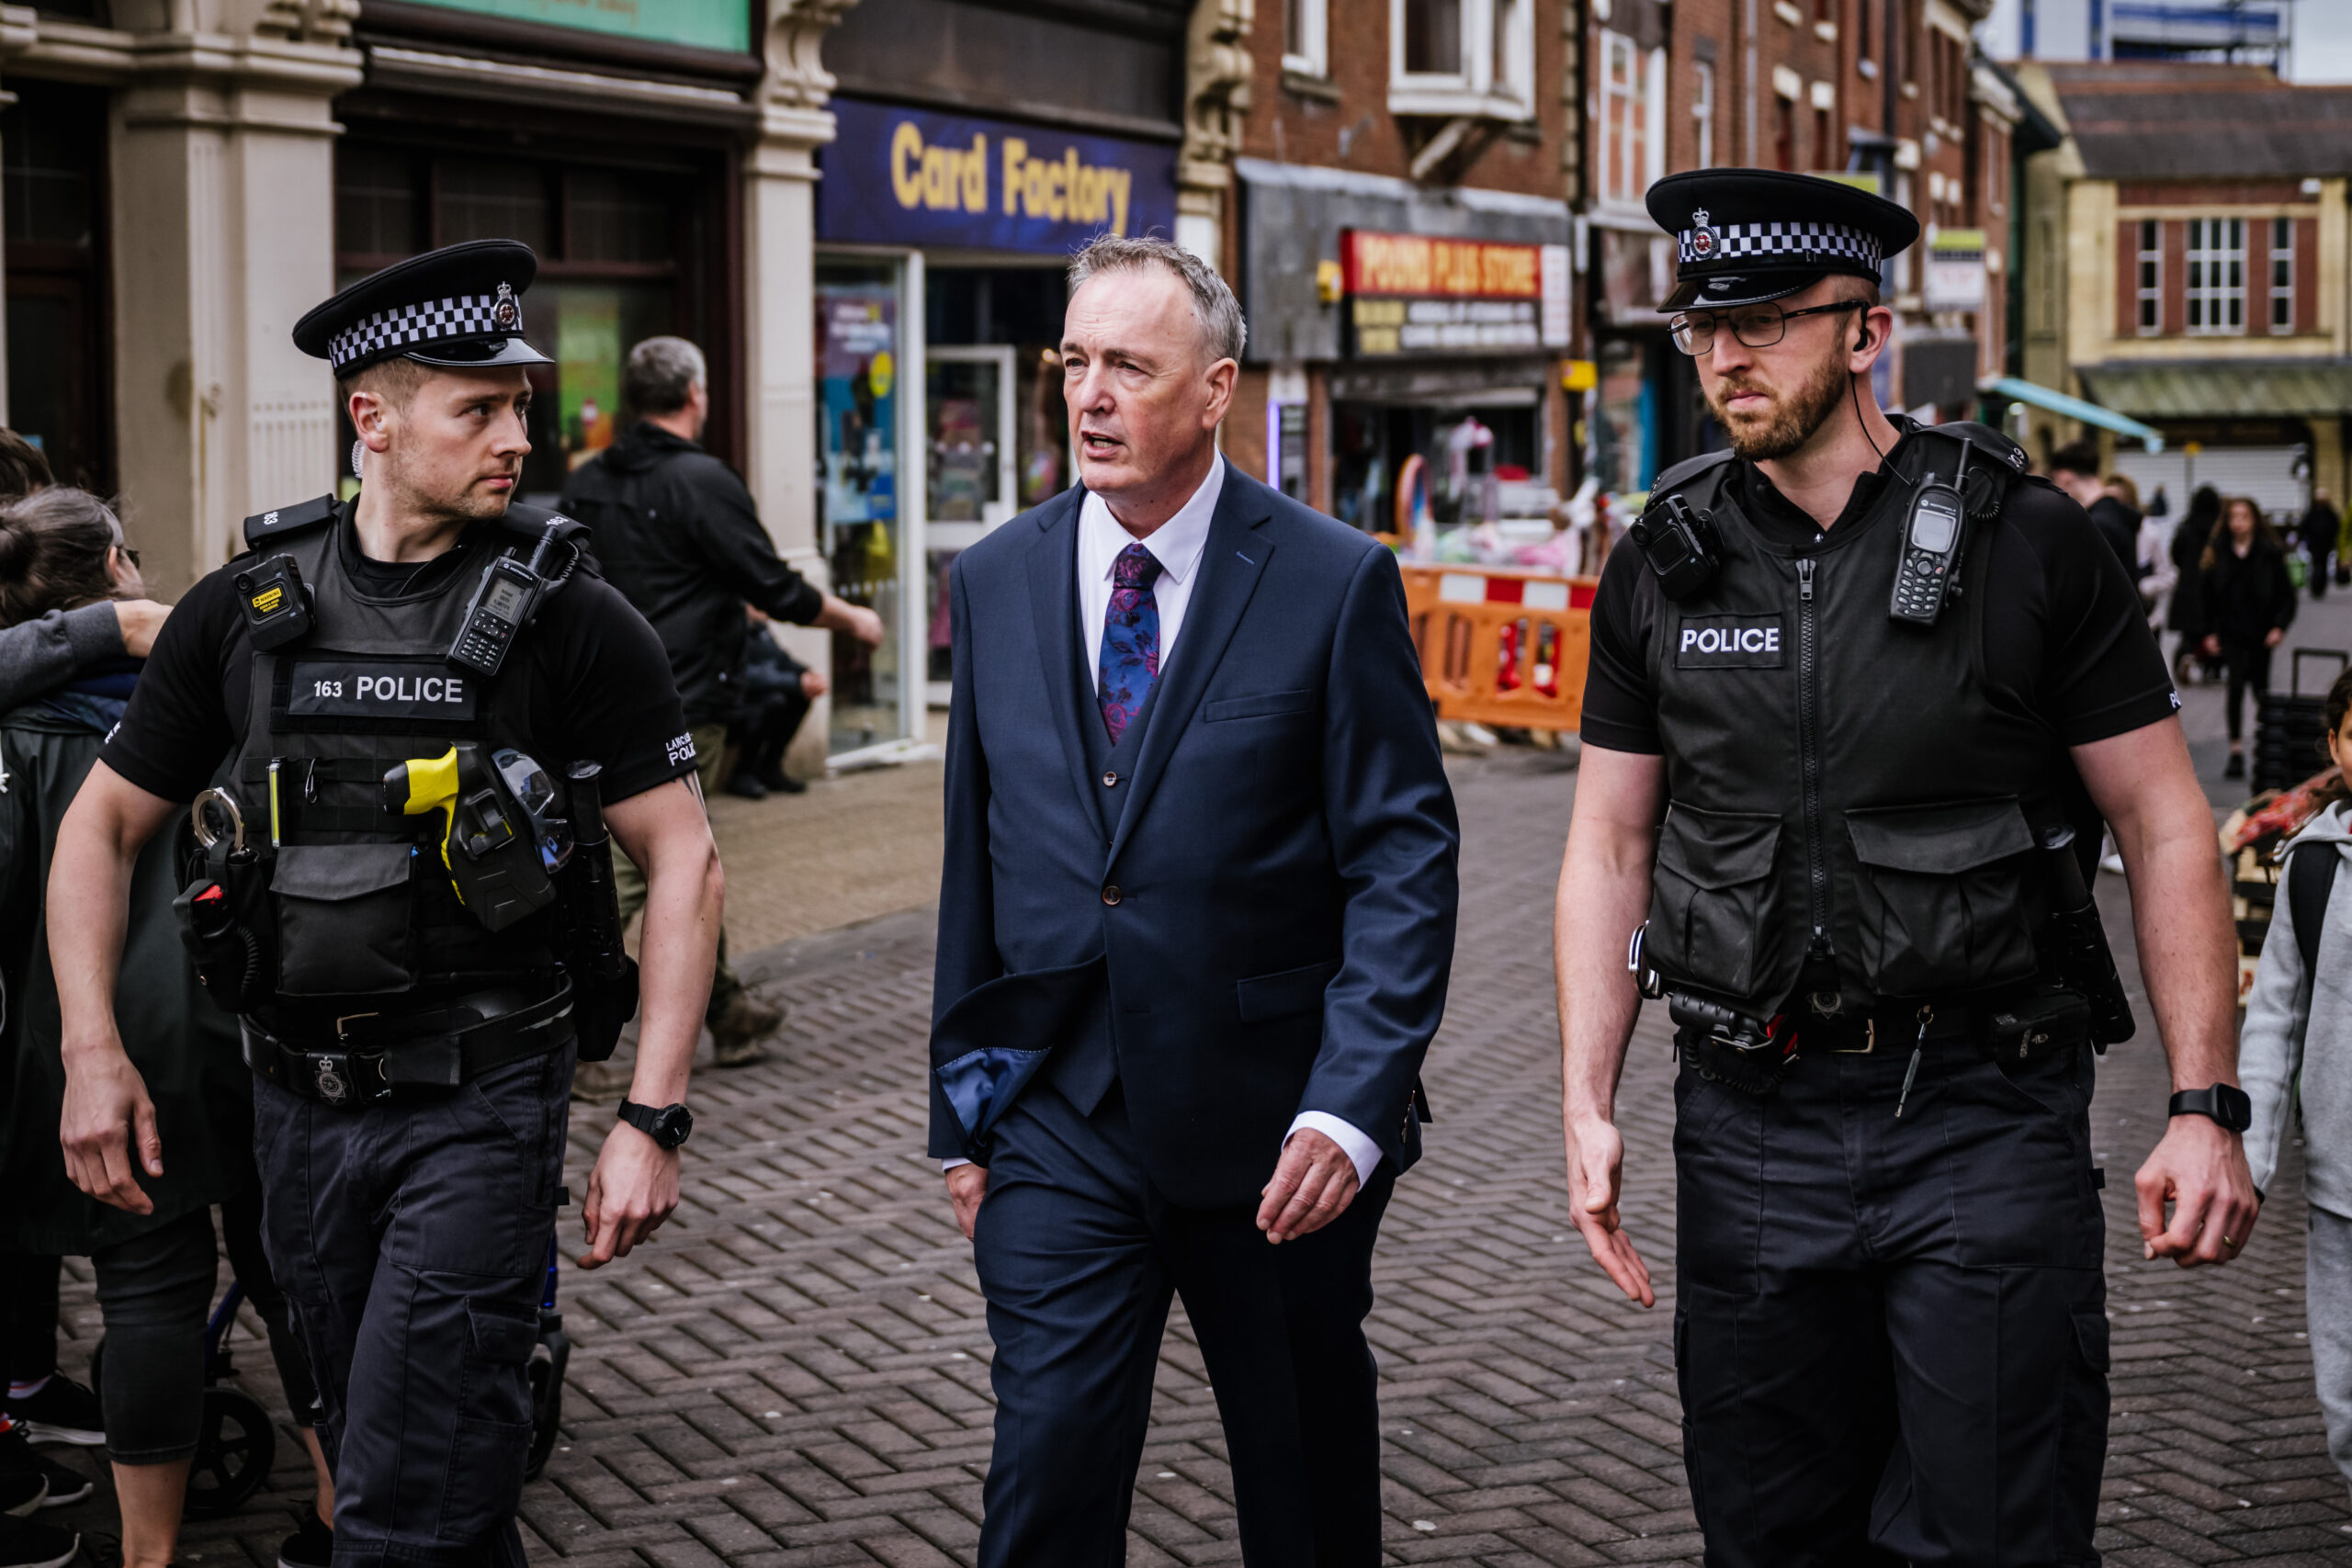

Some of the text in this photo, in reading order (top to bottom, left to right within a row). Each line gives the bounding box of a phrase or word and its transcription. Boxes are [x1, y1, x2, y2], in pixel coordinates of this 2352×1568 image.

[890, 120, 1131, 239] Card Factory
[1680, 627, 1780, 653] POLICE
[314, 675, 463, 703] 163 POLICE
